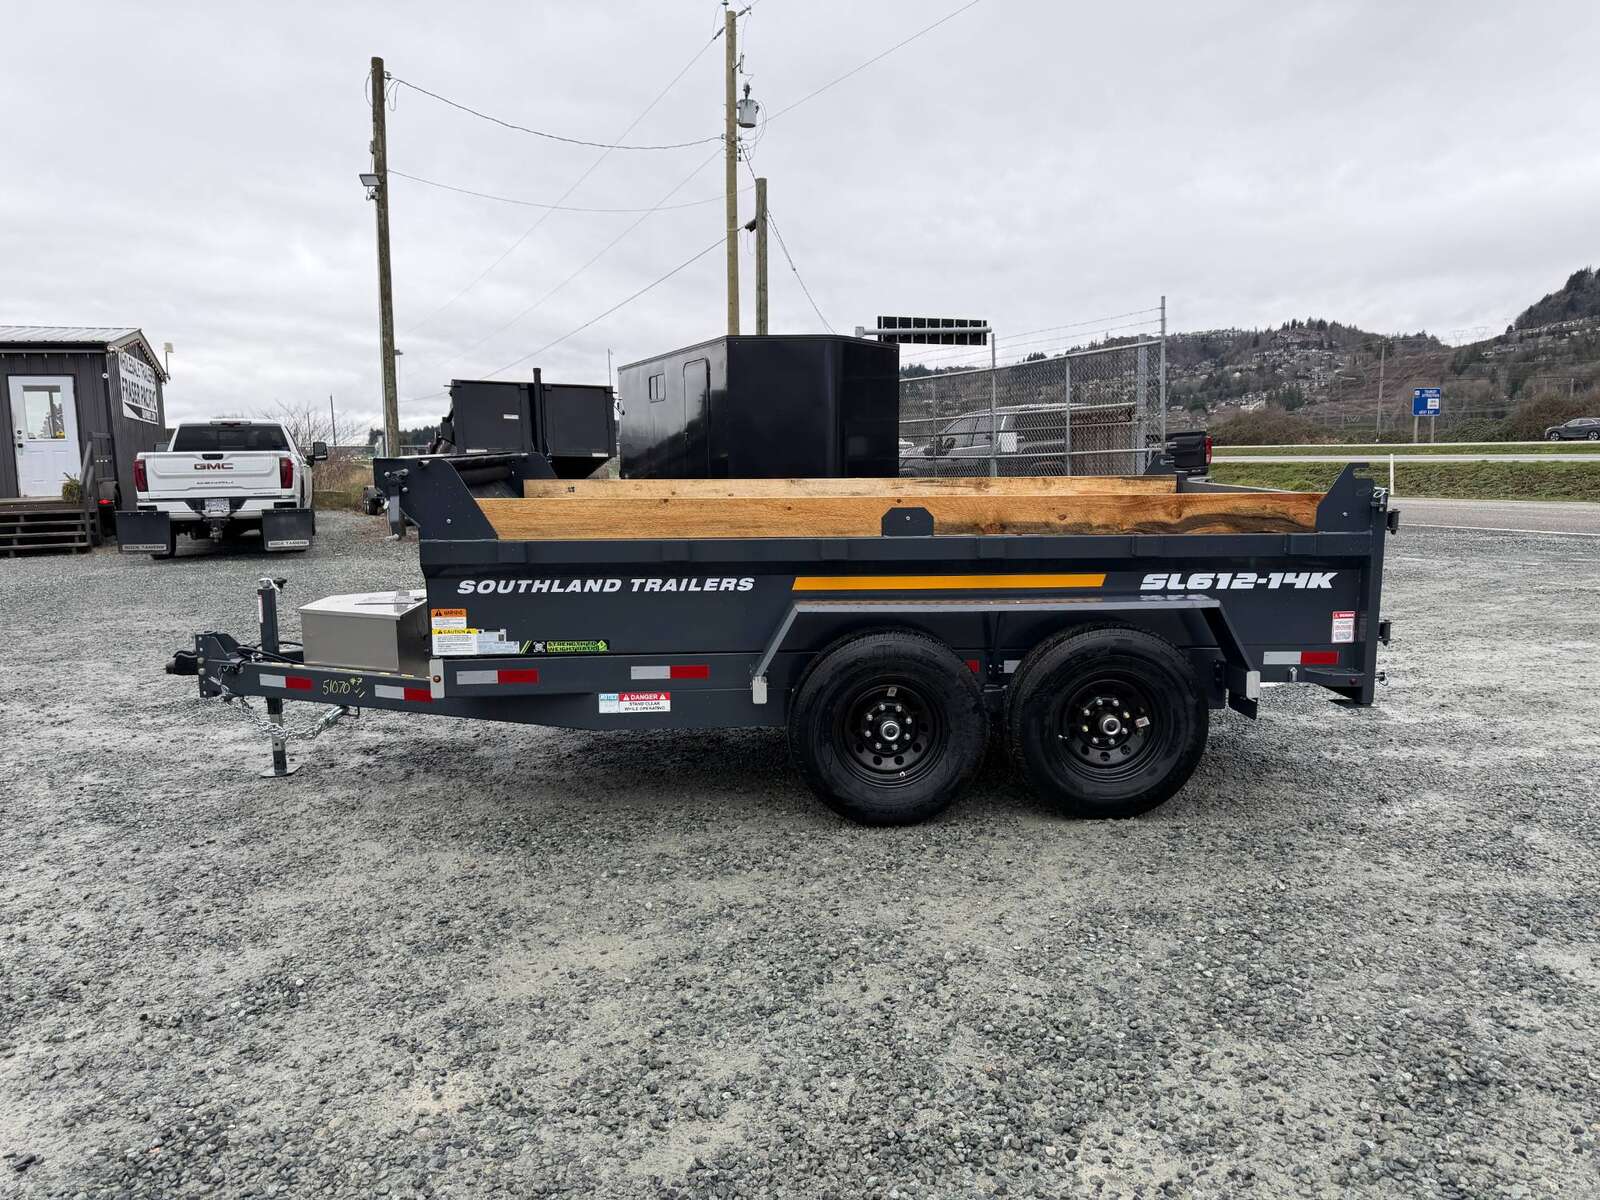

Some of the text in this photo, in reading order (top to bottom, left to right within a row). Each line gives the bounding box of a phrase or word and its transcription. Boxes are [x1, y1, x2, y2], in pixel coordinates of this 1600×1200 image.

[457, 578, 755, 594] SOUTHLAND TRAILERS
[1140, 572, 1338, 590] SL612-14K
[322, 680, 350, 695] 51070
